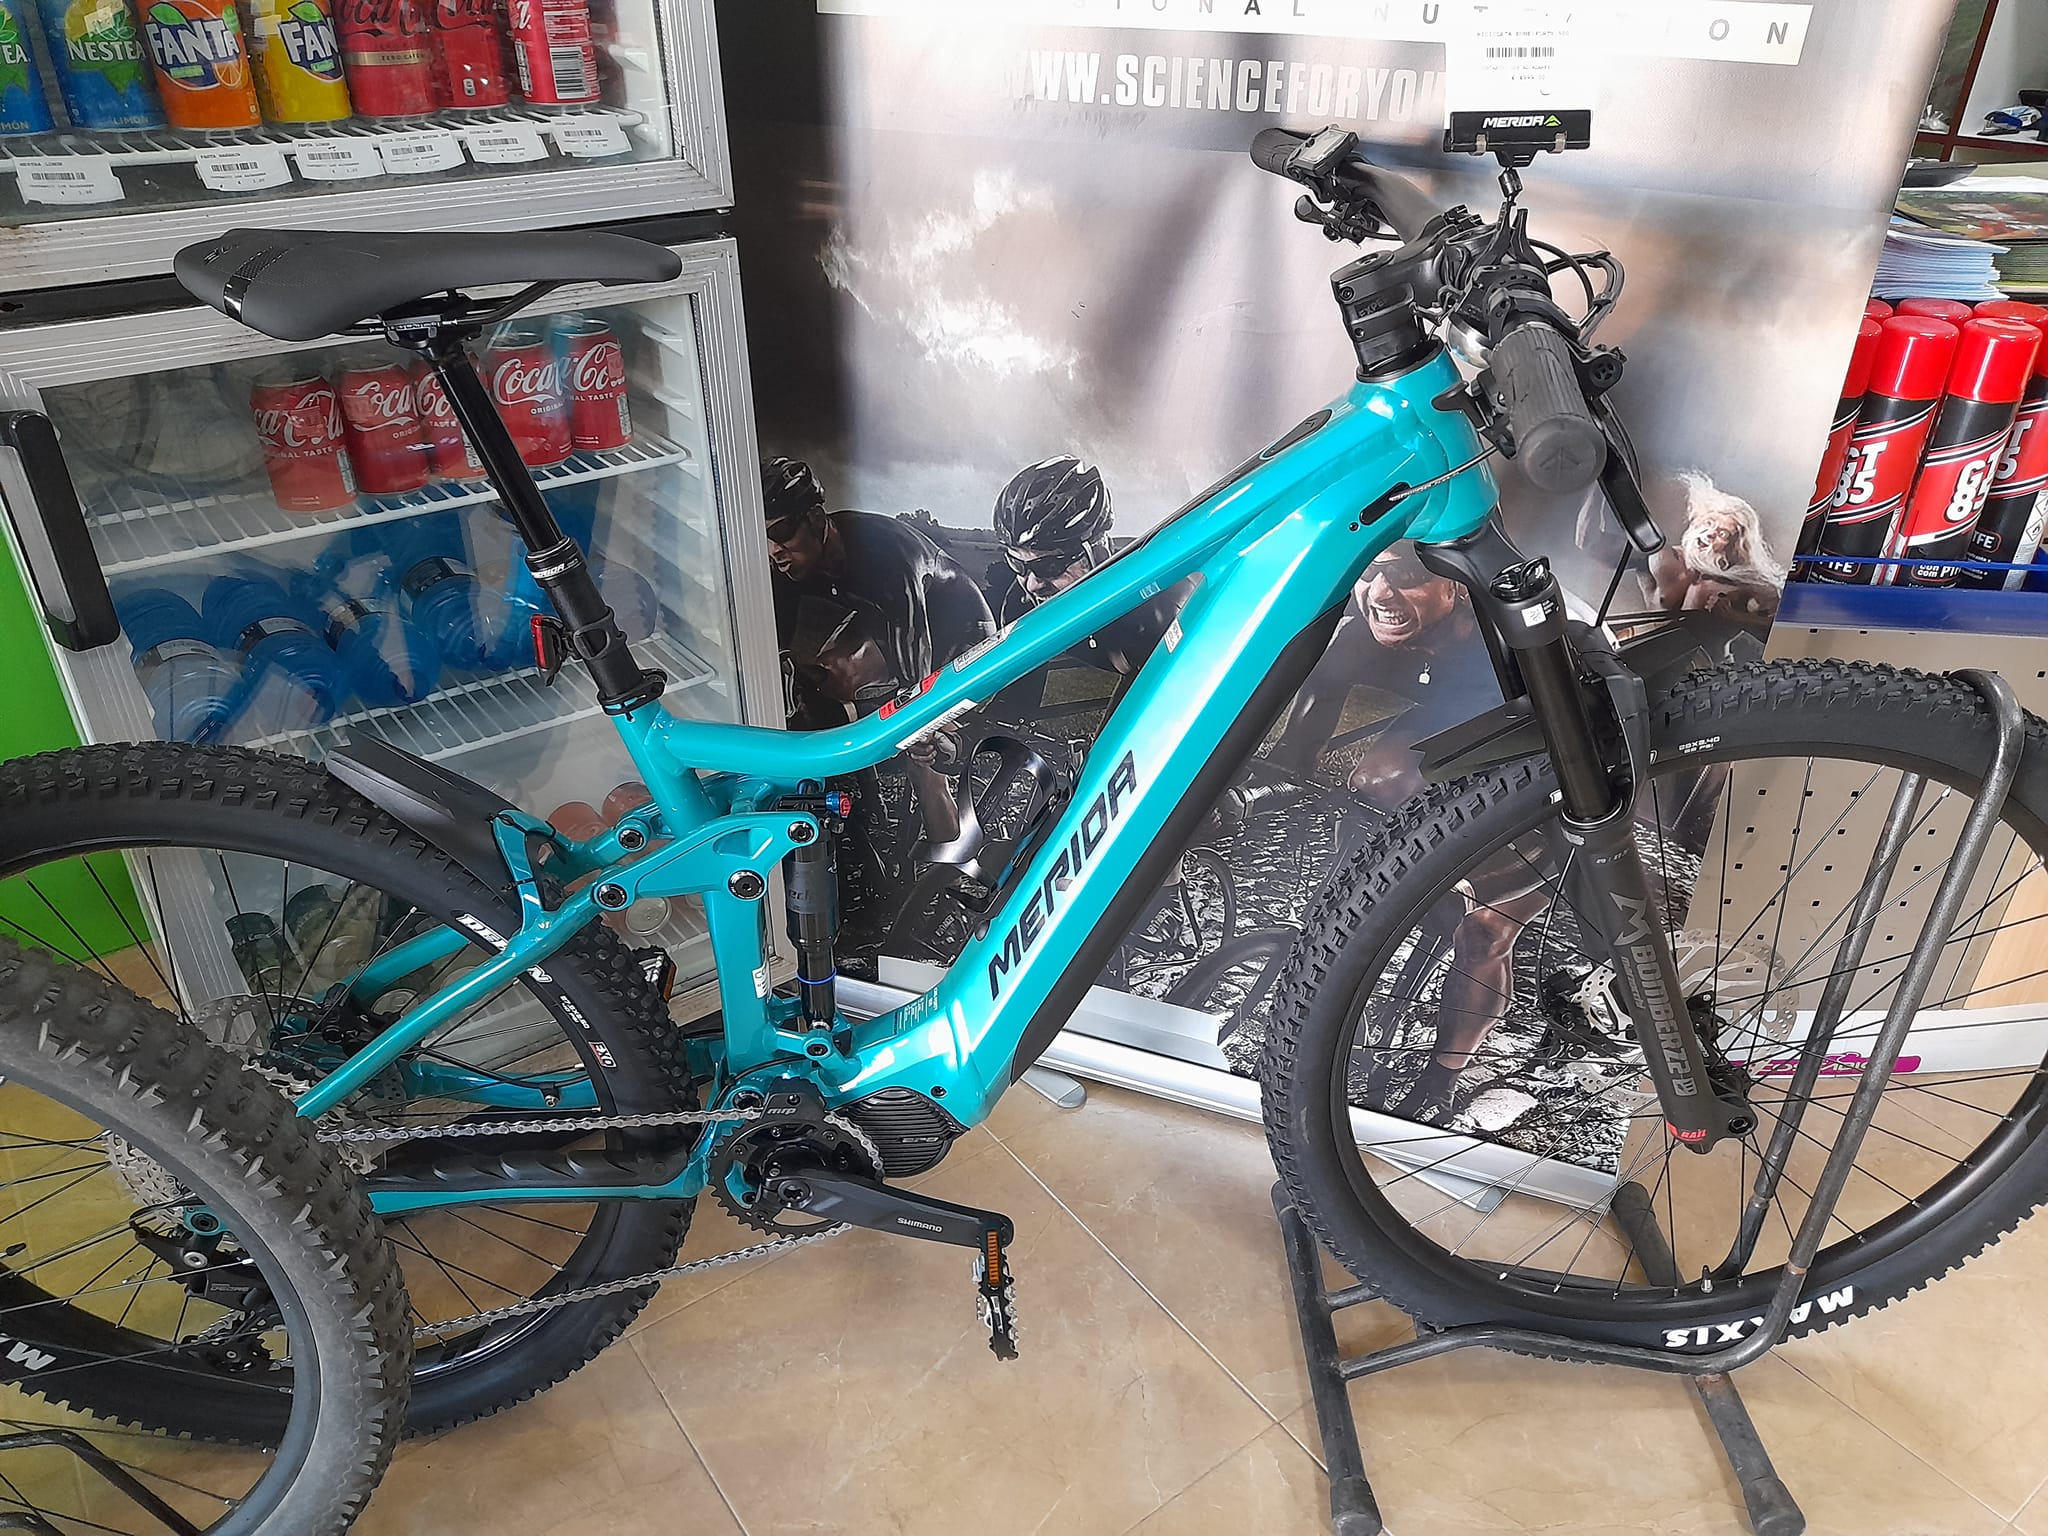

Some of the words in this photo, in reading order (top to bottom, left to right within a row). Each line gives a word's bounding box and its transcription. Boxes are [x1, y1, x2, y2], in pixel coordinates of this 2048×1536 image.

[66, 39, 147, 62] NESTEA
[145, 20, 240, 65] FANTA
[1, 44, 30, 64] EA
[1482, 115, 1544, 129] MERIDA
[588, 393, 615, 402] TASTE
[303, 447, 334, 457] TASTE
[1842, 440, 1888, 478] GT
[1831, 468, 1878, 508] 85
[987, 749, 1137, 1001] MERIDA
[592, 1042, 616, 1068] EXO
[767, 1107, 797, 1116] mrp
[896, 1216, 943, 1233] SHIMANO
